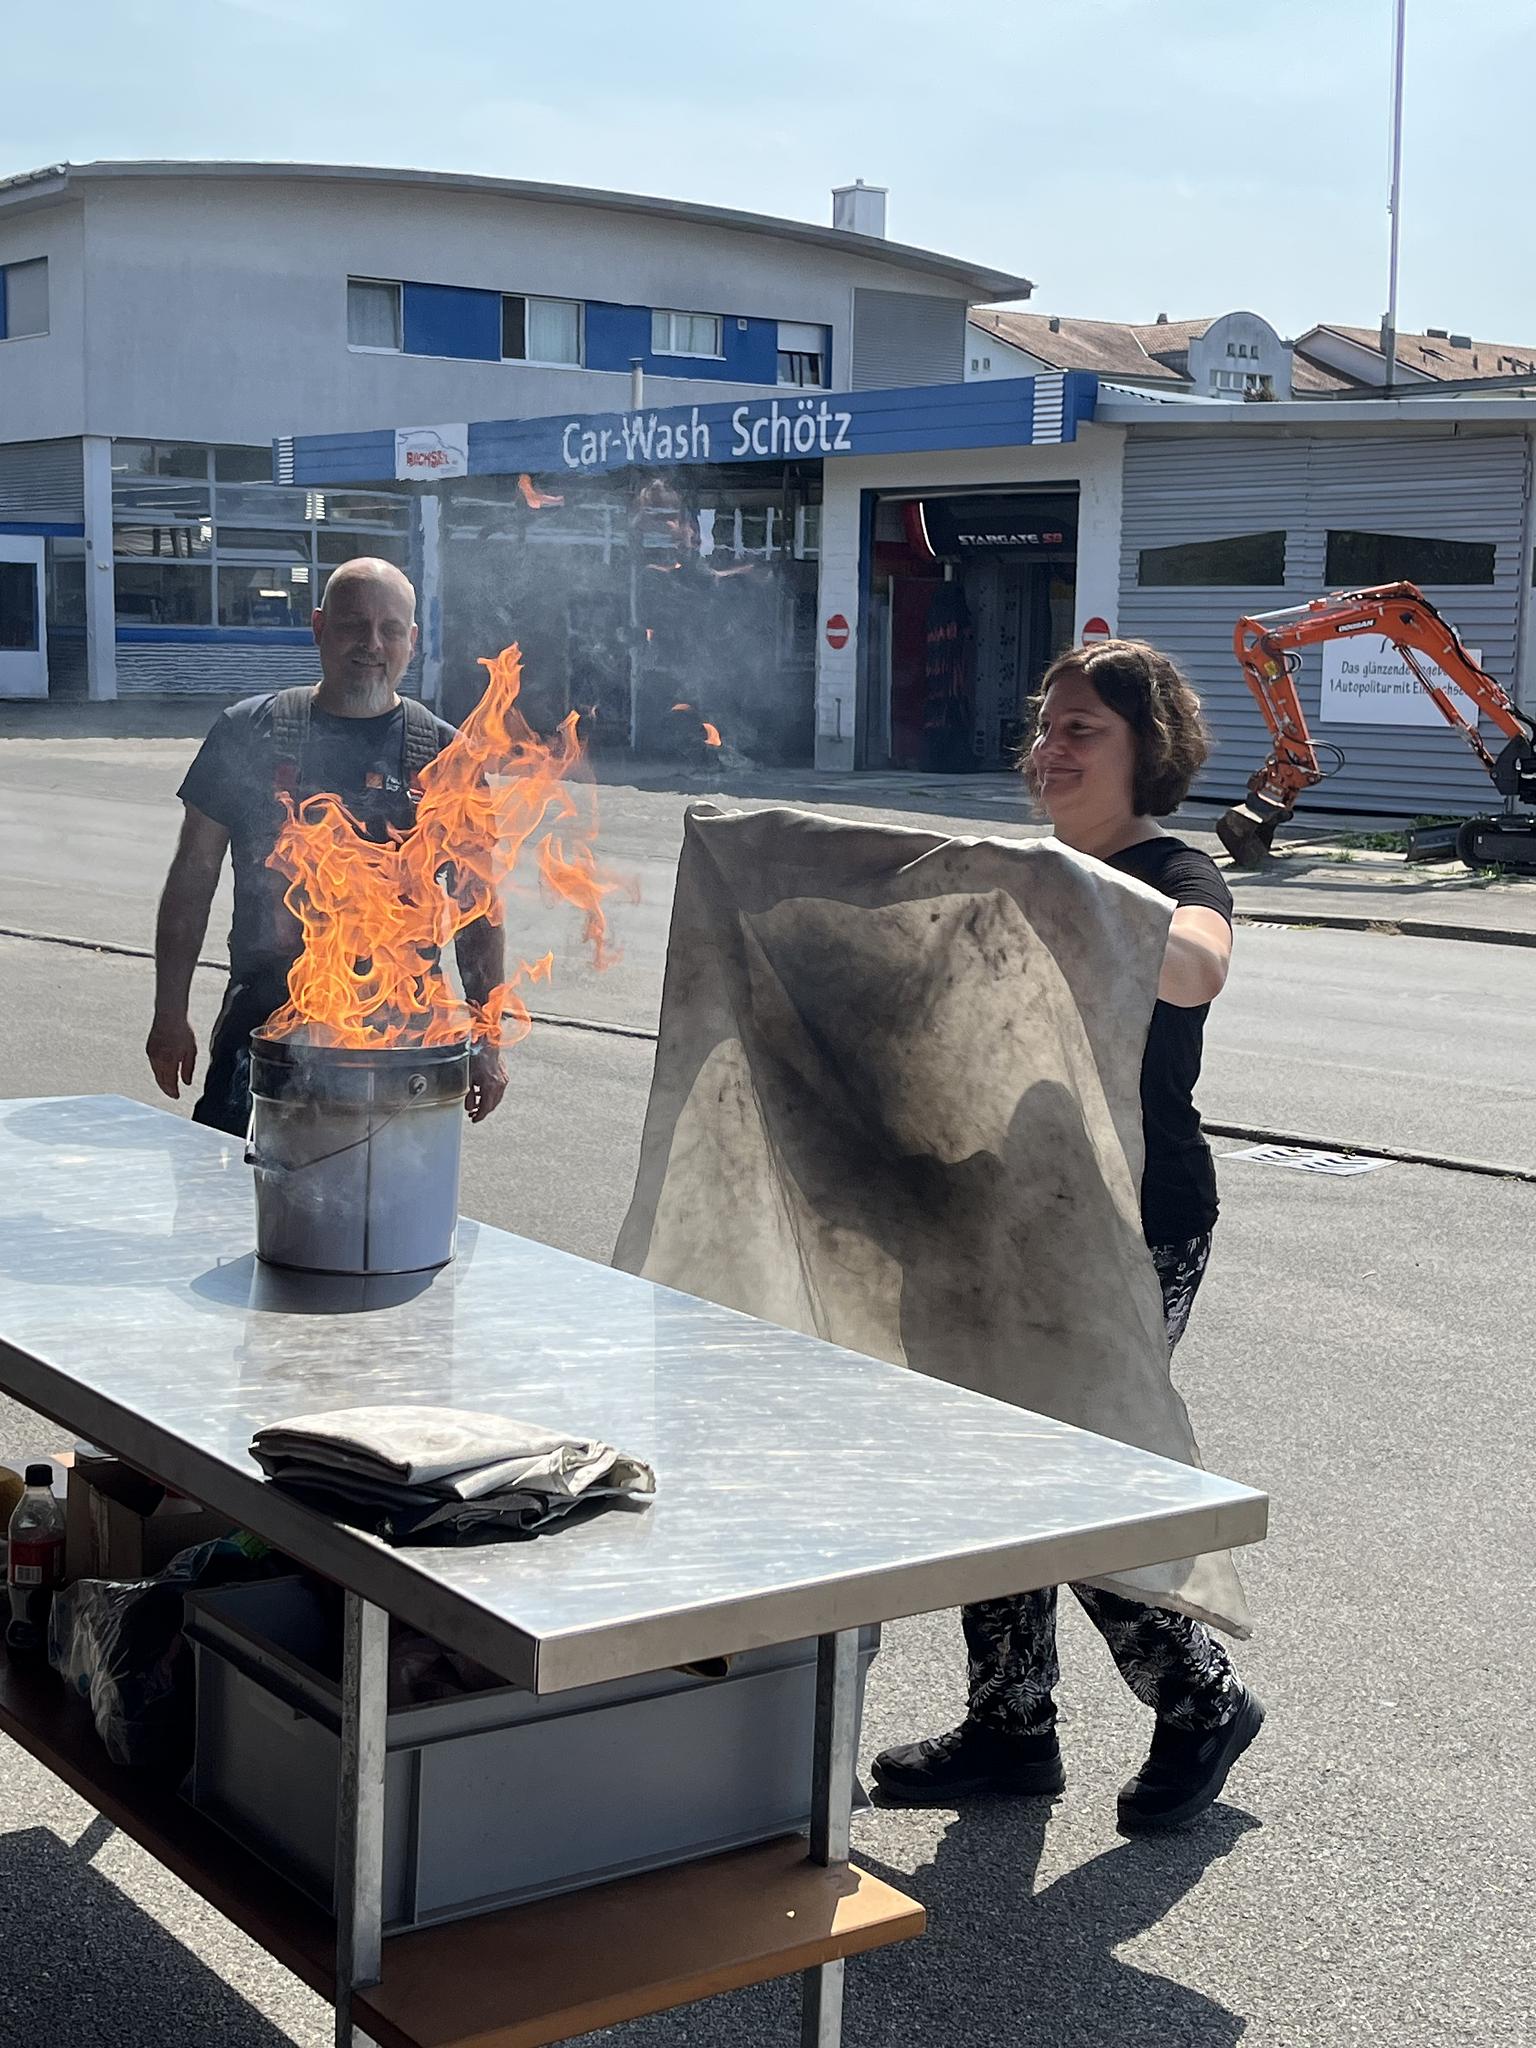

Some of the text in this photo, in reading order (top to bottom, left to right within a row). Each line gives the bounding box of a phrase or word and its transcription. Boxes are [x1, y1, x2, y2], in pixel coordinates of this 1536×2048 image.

[562, 400, 852, 468] Car-Wash Schötz
[958, 534, 1040, 546] STARGATE
[1341, 660, 1360, 675] Das
[1393, 681, 1411, 694] mit
